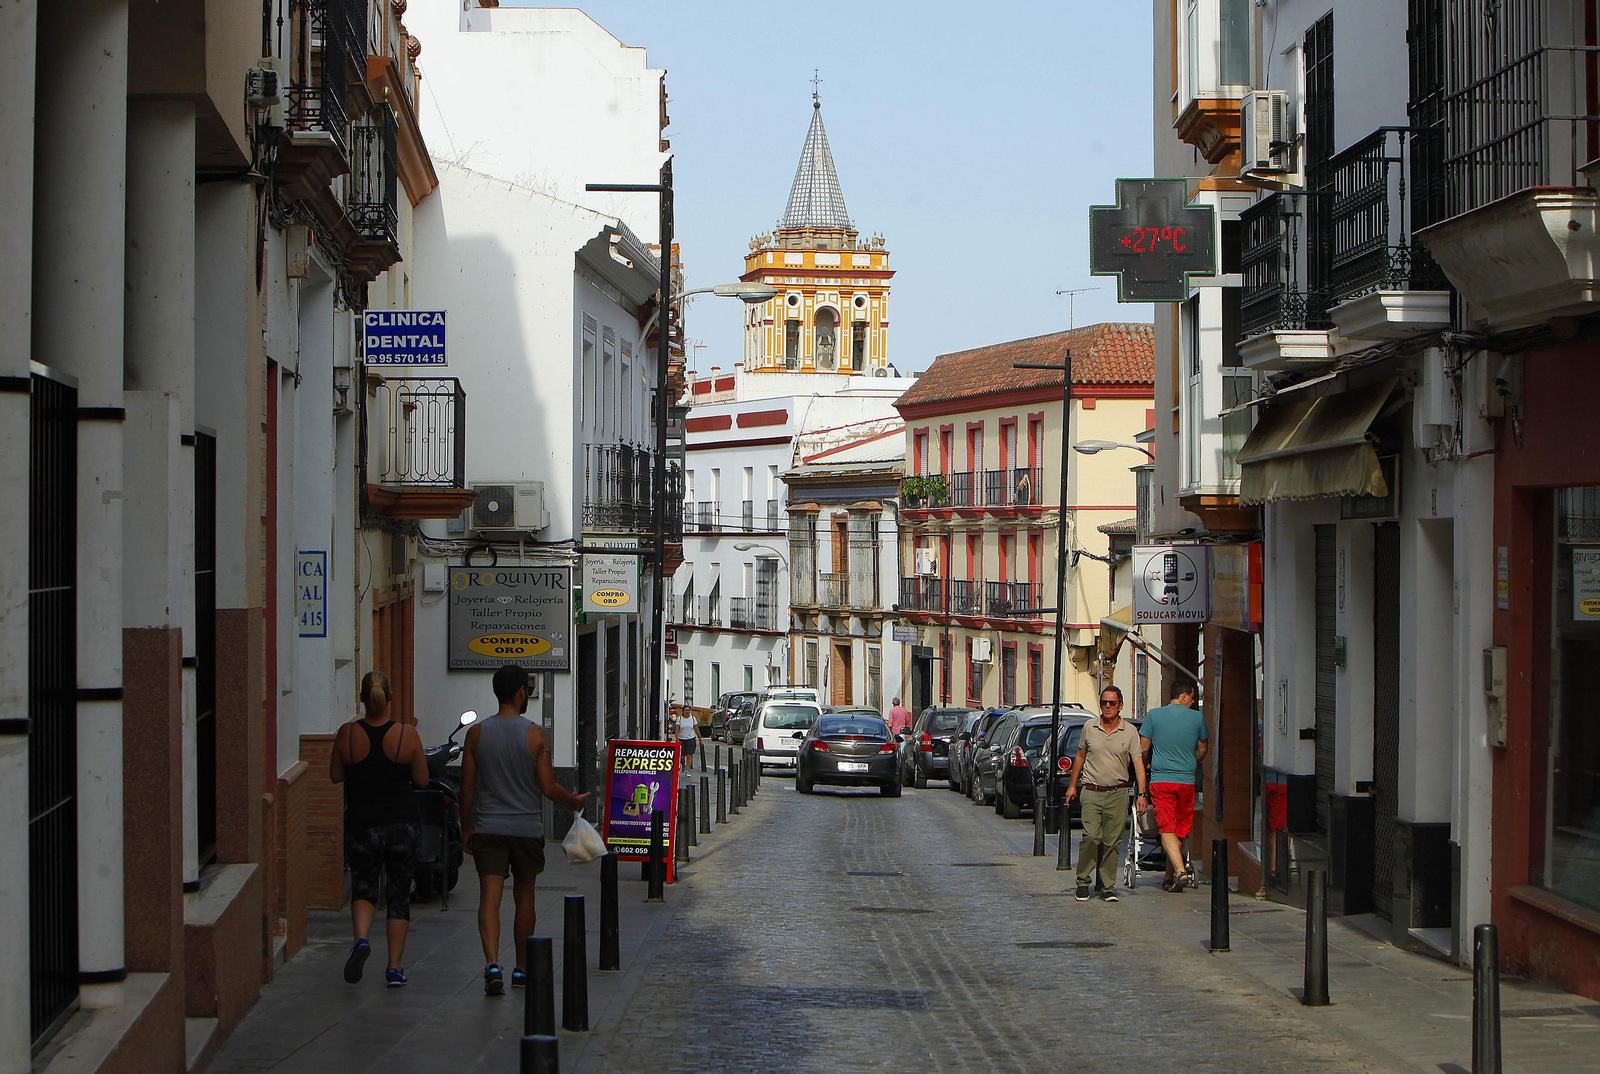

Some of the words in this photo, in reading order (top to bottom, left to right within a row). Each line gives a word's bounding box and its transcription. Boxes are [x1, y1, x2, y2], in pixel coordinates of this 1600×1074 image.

[365, 313, 445, 326] CLINICA
[367, 335, 443, 348] DENTAL
[379, 354, 392, 363] 95
[394, 354, 414, 363] 570
[416, 354, 429, 363] 14
[431, 354, 443, 363] 15
[608, 568, 626, 576] Propio
[452, 572, 566, 591] OROQUIVIR
[454, 595, 495, 606] Joyería
[514, 594, 564, 606] Relojería
[470, 608, 502, 618] Taller
[505, 609, 542, 619] Propio
[1136, 611, 1176, 619] SOLUCAR
[1178, 609, 1205, 619] MÓVIL
[470, 621, 546, 632] Reparaciones
[451, 659, 496, 667] GESTIONAMOS
[530, 659, 540, 667] DE
[540, 658, 567, 667] EMPEÑO
[615, 748, 675, 759] REPARACIÓN
[614, 758, 673, 771] EXPRESS
